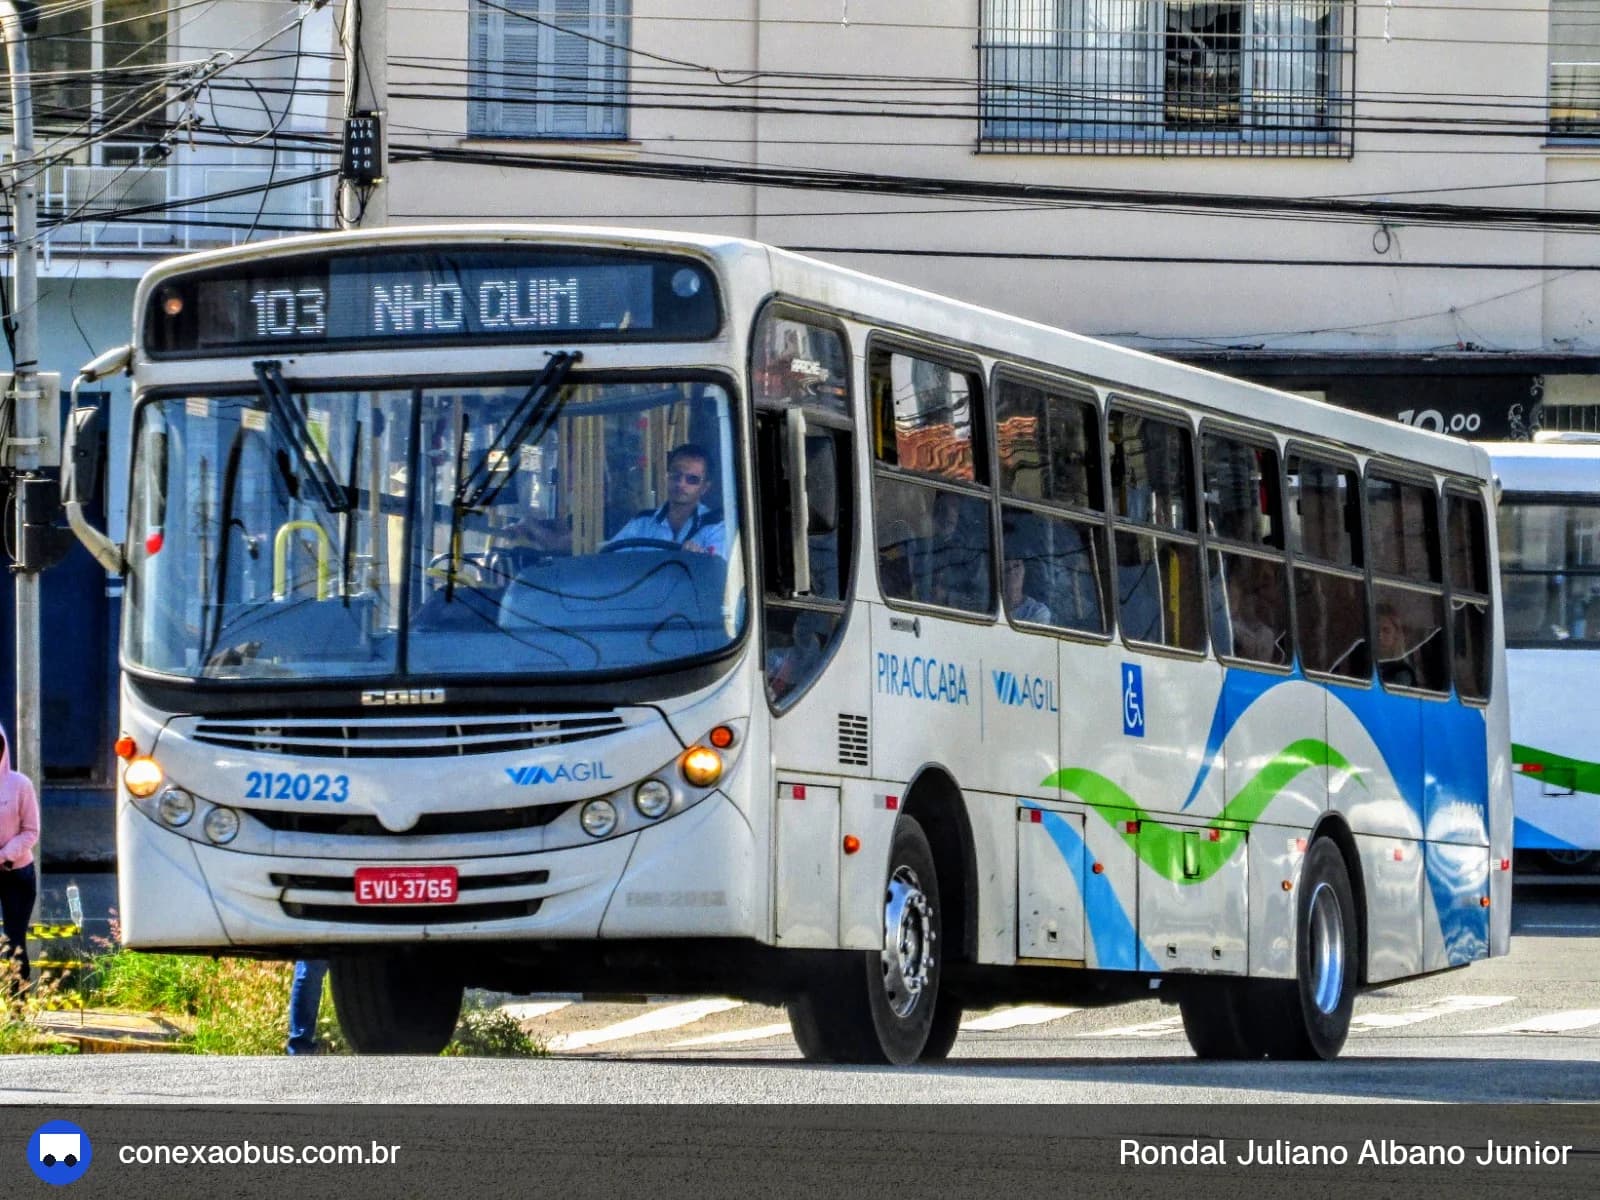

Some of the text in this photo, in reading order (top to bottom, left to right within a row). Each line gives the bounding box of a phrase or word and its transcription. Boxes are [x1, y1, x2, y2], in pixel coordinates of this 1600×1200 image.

[249, 278, 581, 336] 103 NHO QUIM
[361, 687, 446, 706] CAIO
[877, 652, 969, 706] PIRACICABA
[245, 770, 350, 803] 212023
